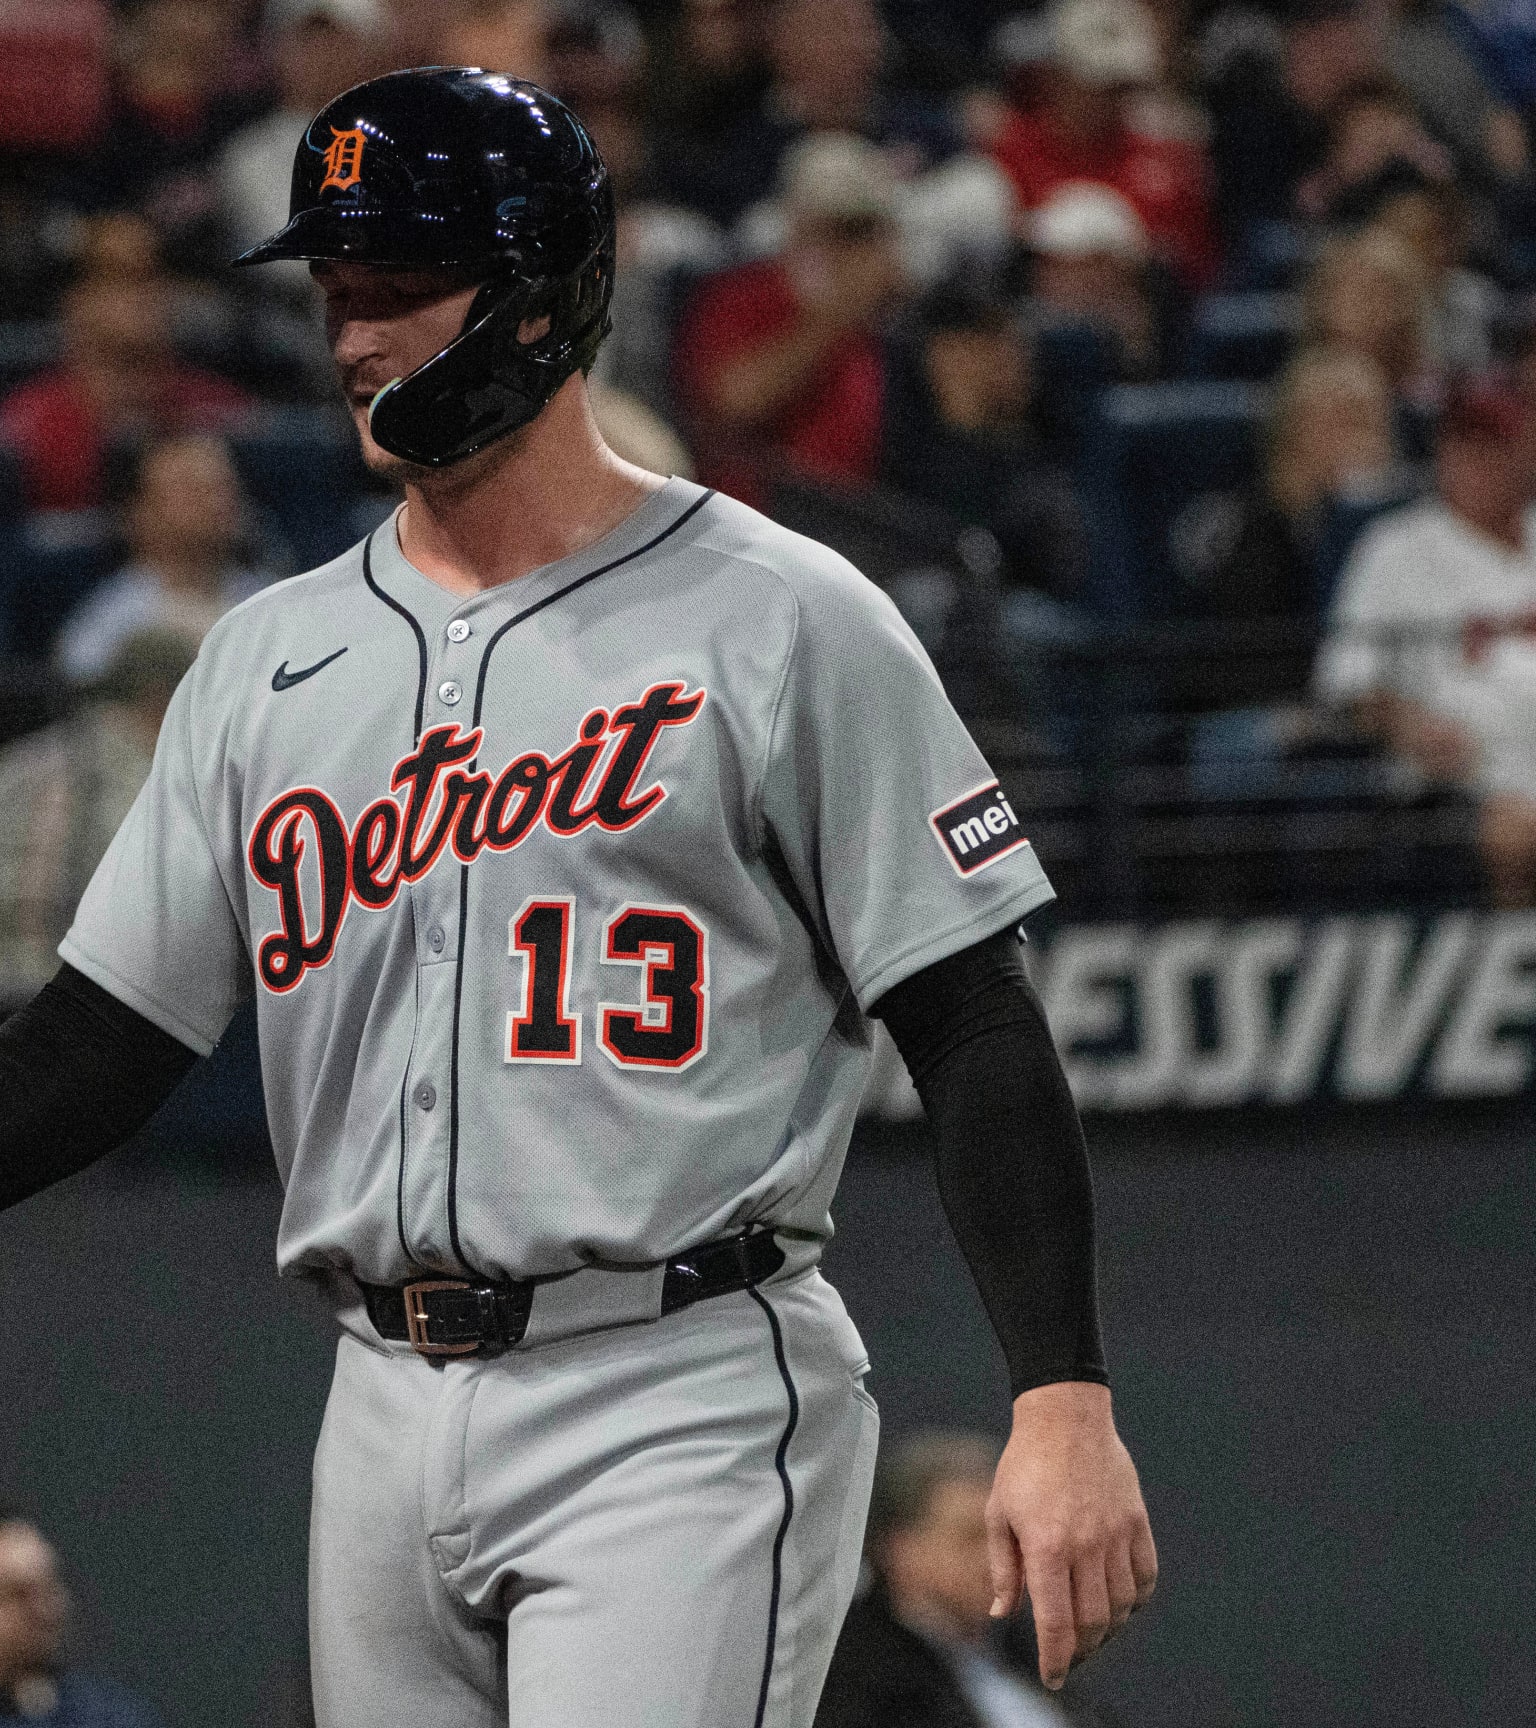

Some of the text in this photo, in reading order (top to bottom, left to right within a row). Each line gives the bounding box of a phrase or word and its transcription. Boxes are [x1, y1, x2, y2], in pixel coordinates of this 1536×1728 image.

[320, 124, 367, 194] D
[249, 680, 706, 994] Detroit
[504, 895, 710, 1074] 13
[864, 908, 1536, 1118] ESSIVE
